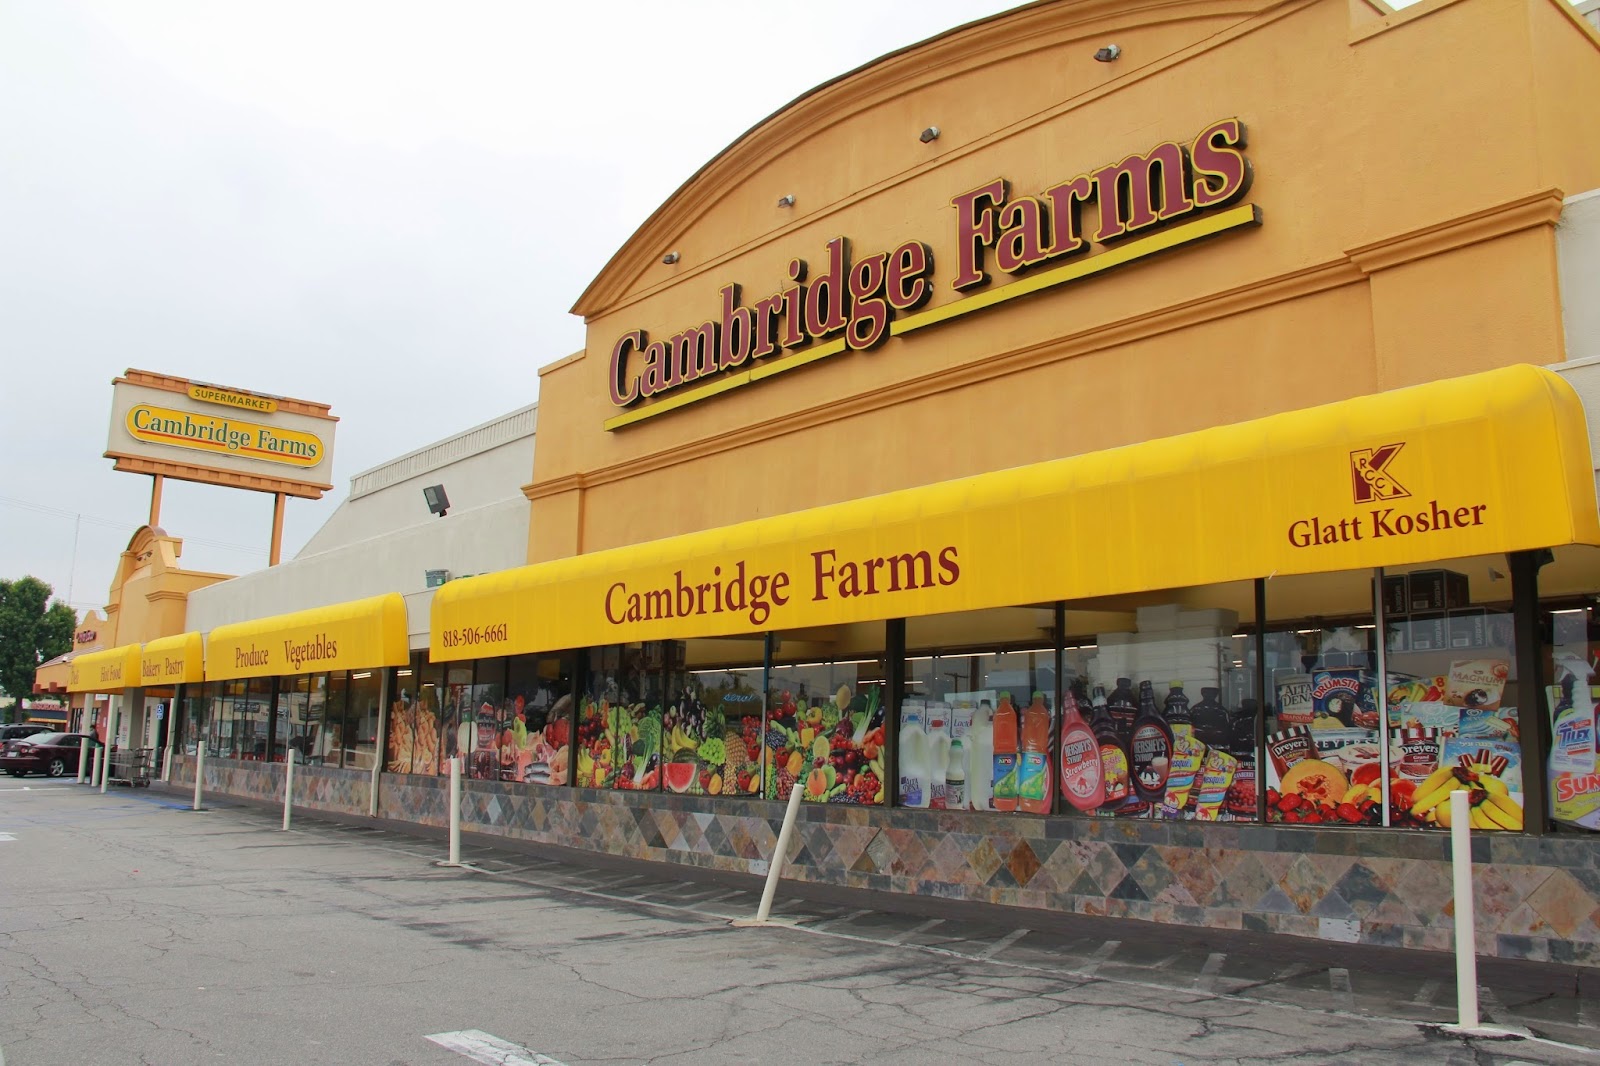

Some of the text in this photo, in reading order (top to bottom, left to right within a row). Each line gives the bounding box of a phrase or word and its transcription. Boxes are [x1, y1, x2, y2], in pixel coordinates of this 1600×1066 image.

[609, 116, 1256, 409] Cambridge Farms
[194, 389, 272, 410] SUPERMARKET
[133, 409, 318, 458] Cambridge Farms
[1288, 500, 1487, 547] Glatt Kosher
[605, 545, 960, 625] Cambridge Farms
[443, 623, 508, 648] 818-506-6661
[235, 633, 338, 671] Produce Vegetables
[142, 657, 184, 681] Bakery Pastry
[1452, 671, 1504, 685] MAGNUM
[1286, 684, 1312, 697] ALTA
[1273, 739, 1308, 756] Dreyer's
[1065, 758, 1098, 778] Strawberry
